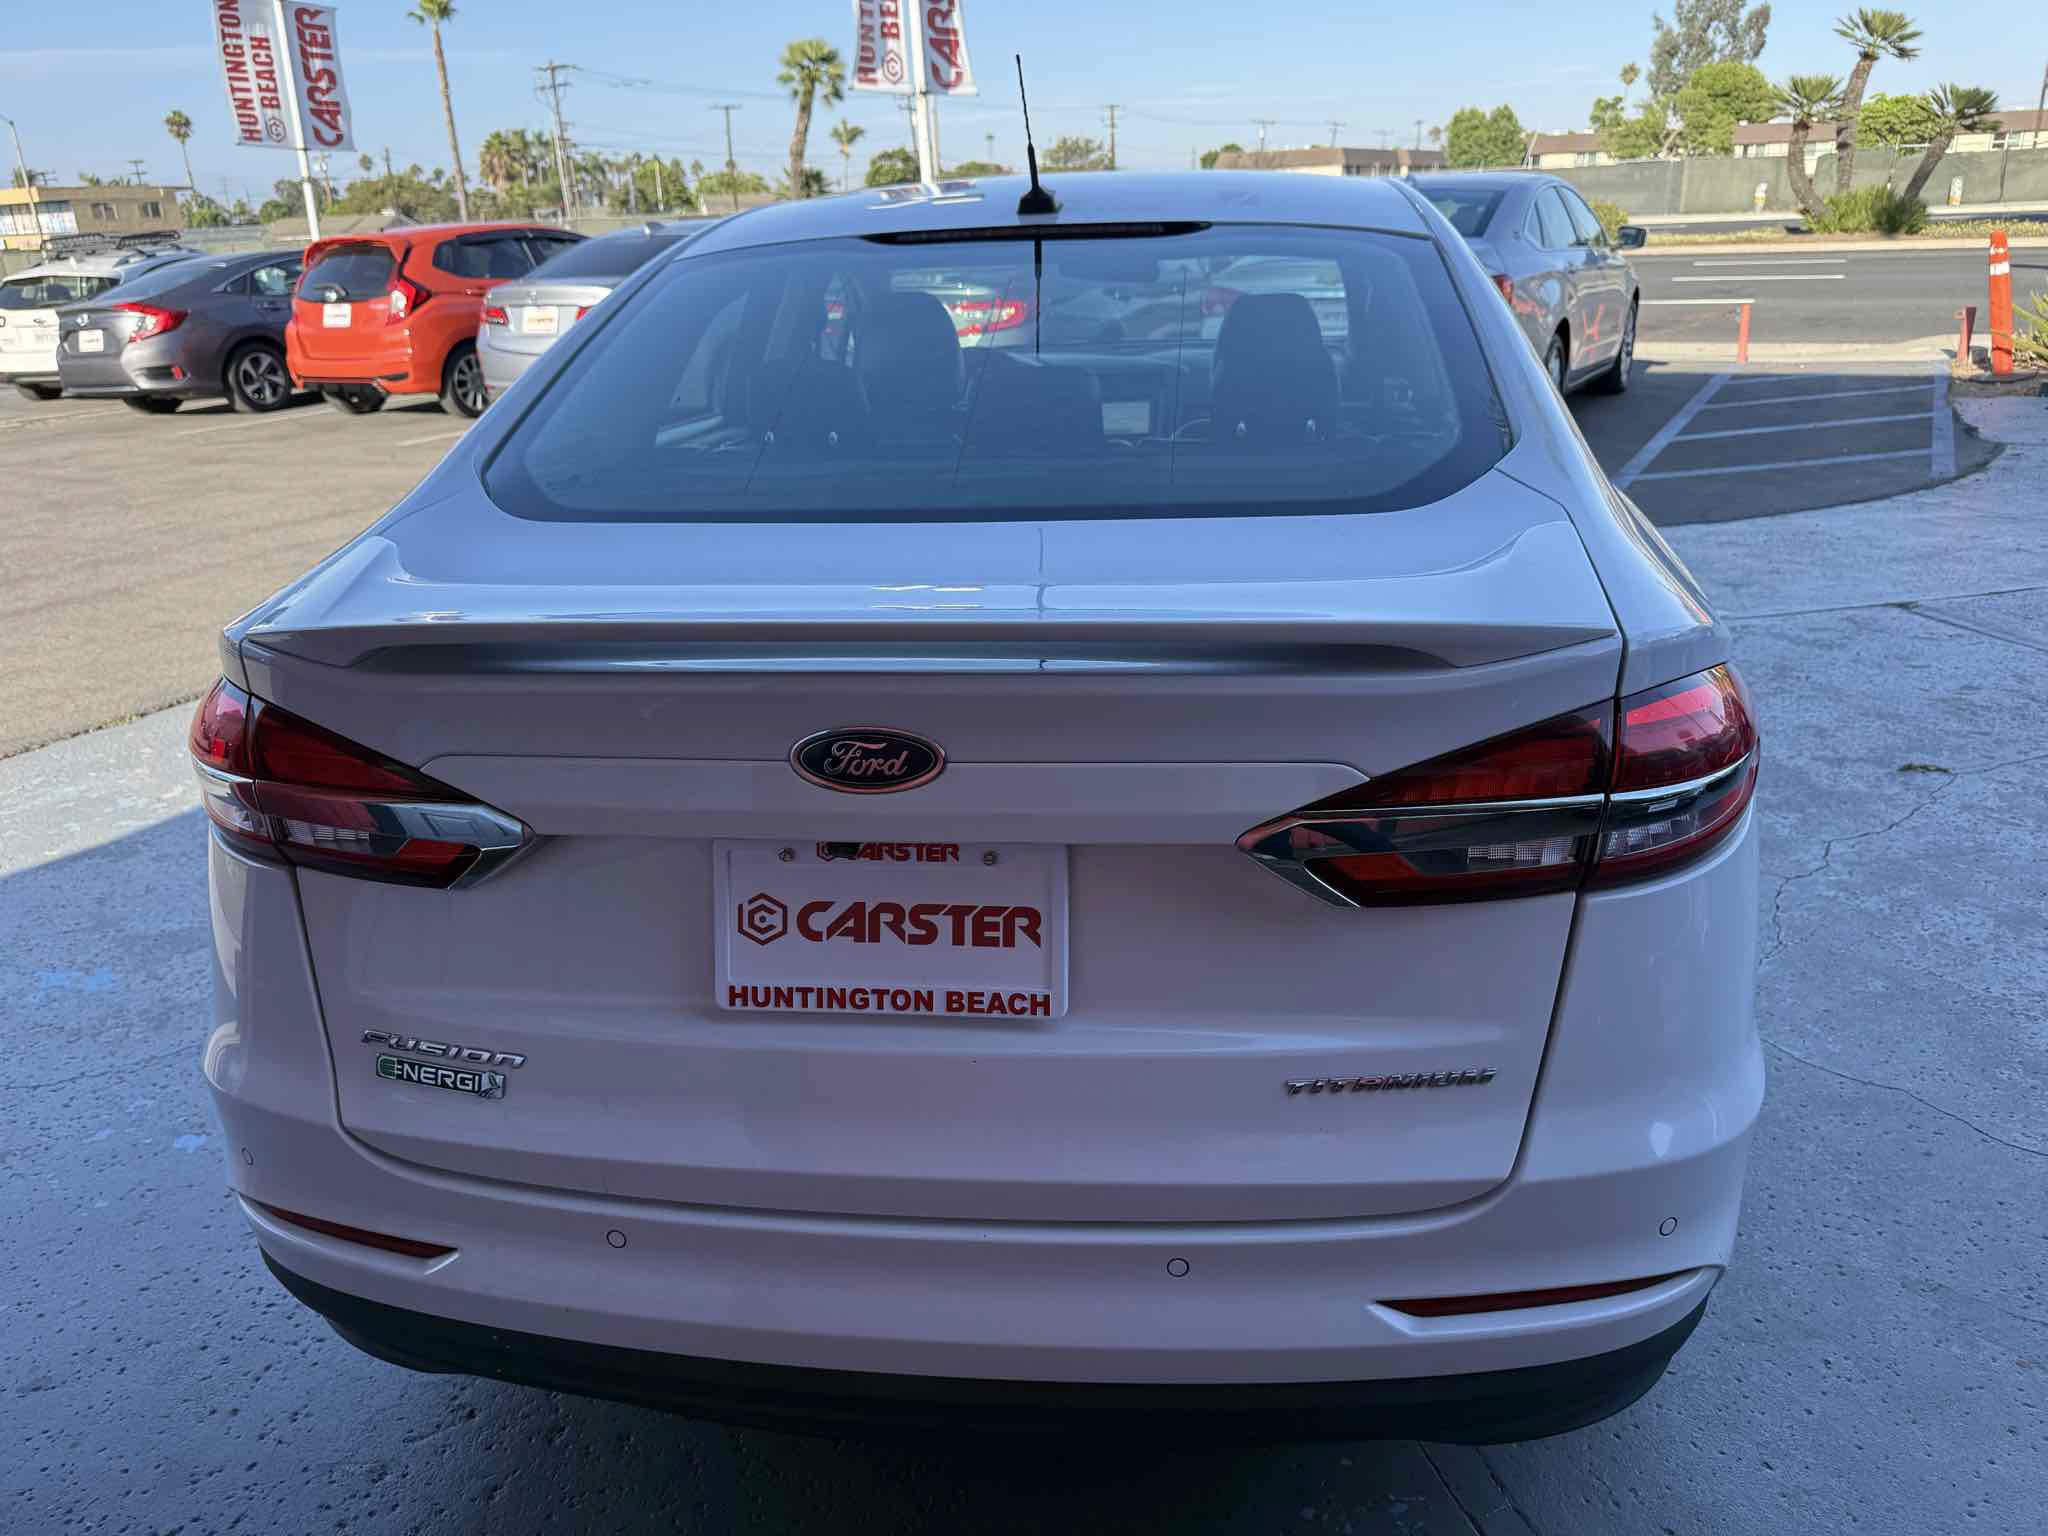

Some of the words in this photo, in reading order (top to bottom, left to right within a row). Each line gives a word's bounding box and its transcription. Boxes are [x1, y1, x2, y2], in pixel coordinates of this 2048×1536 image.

[218, 0, 263, 143] HUNTINGTON
[250, 35, 281, 109] BEACH
[295, 7, 344, 147] CARSTER
[824, 740, 909, 776] Ford
[846, 842, 960, 862] ARSTER
[796, 900, 1042, 949] CARSTER
[728, 985, 934, 1013] HUNTINGTON
[945, 990, 1051, 1017] BEACH
[361, 1029, 528, 1068] FUSION
